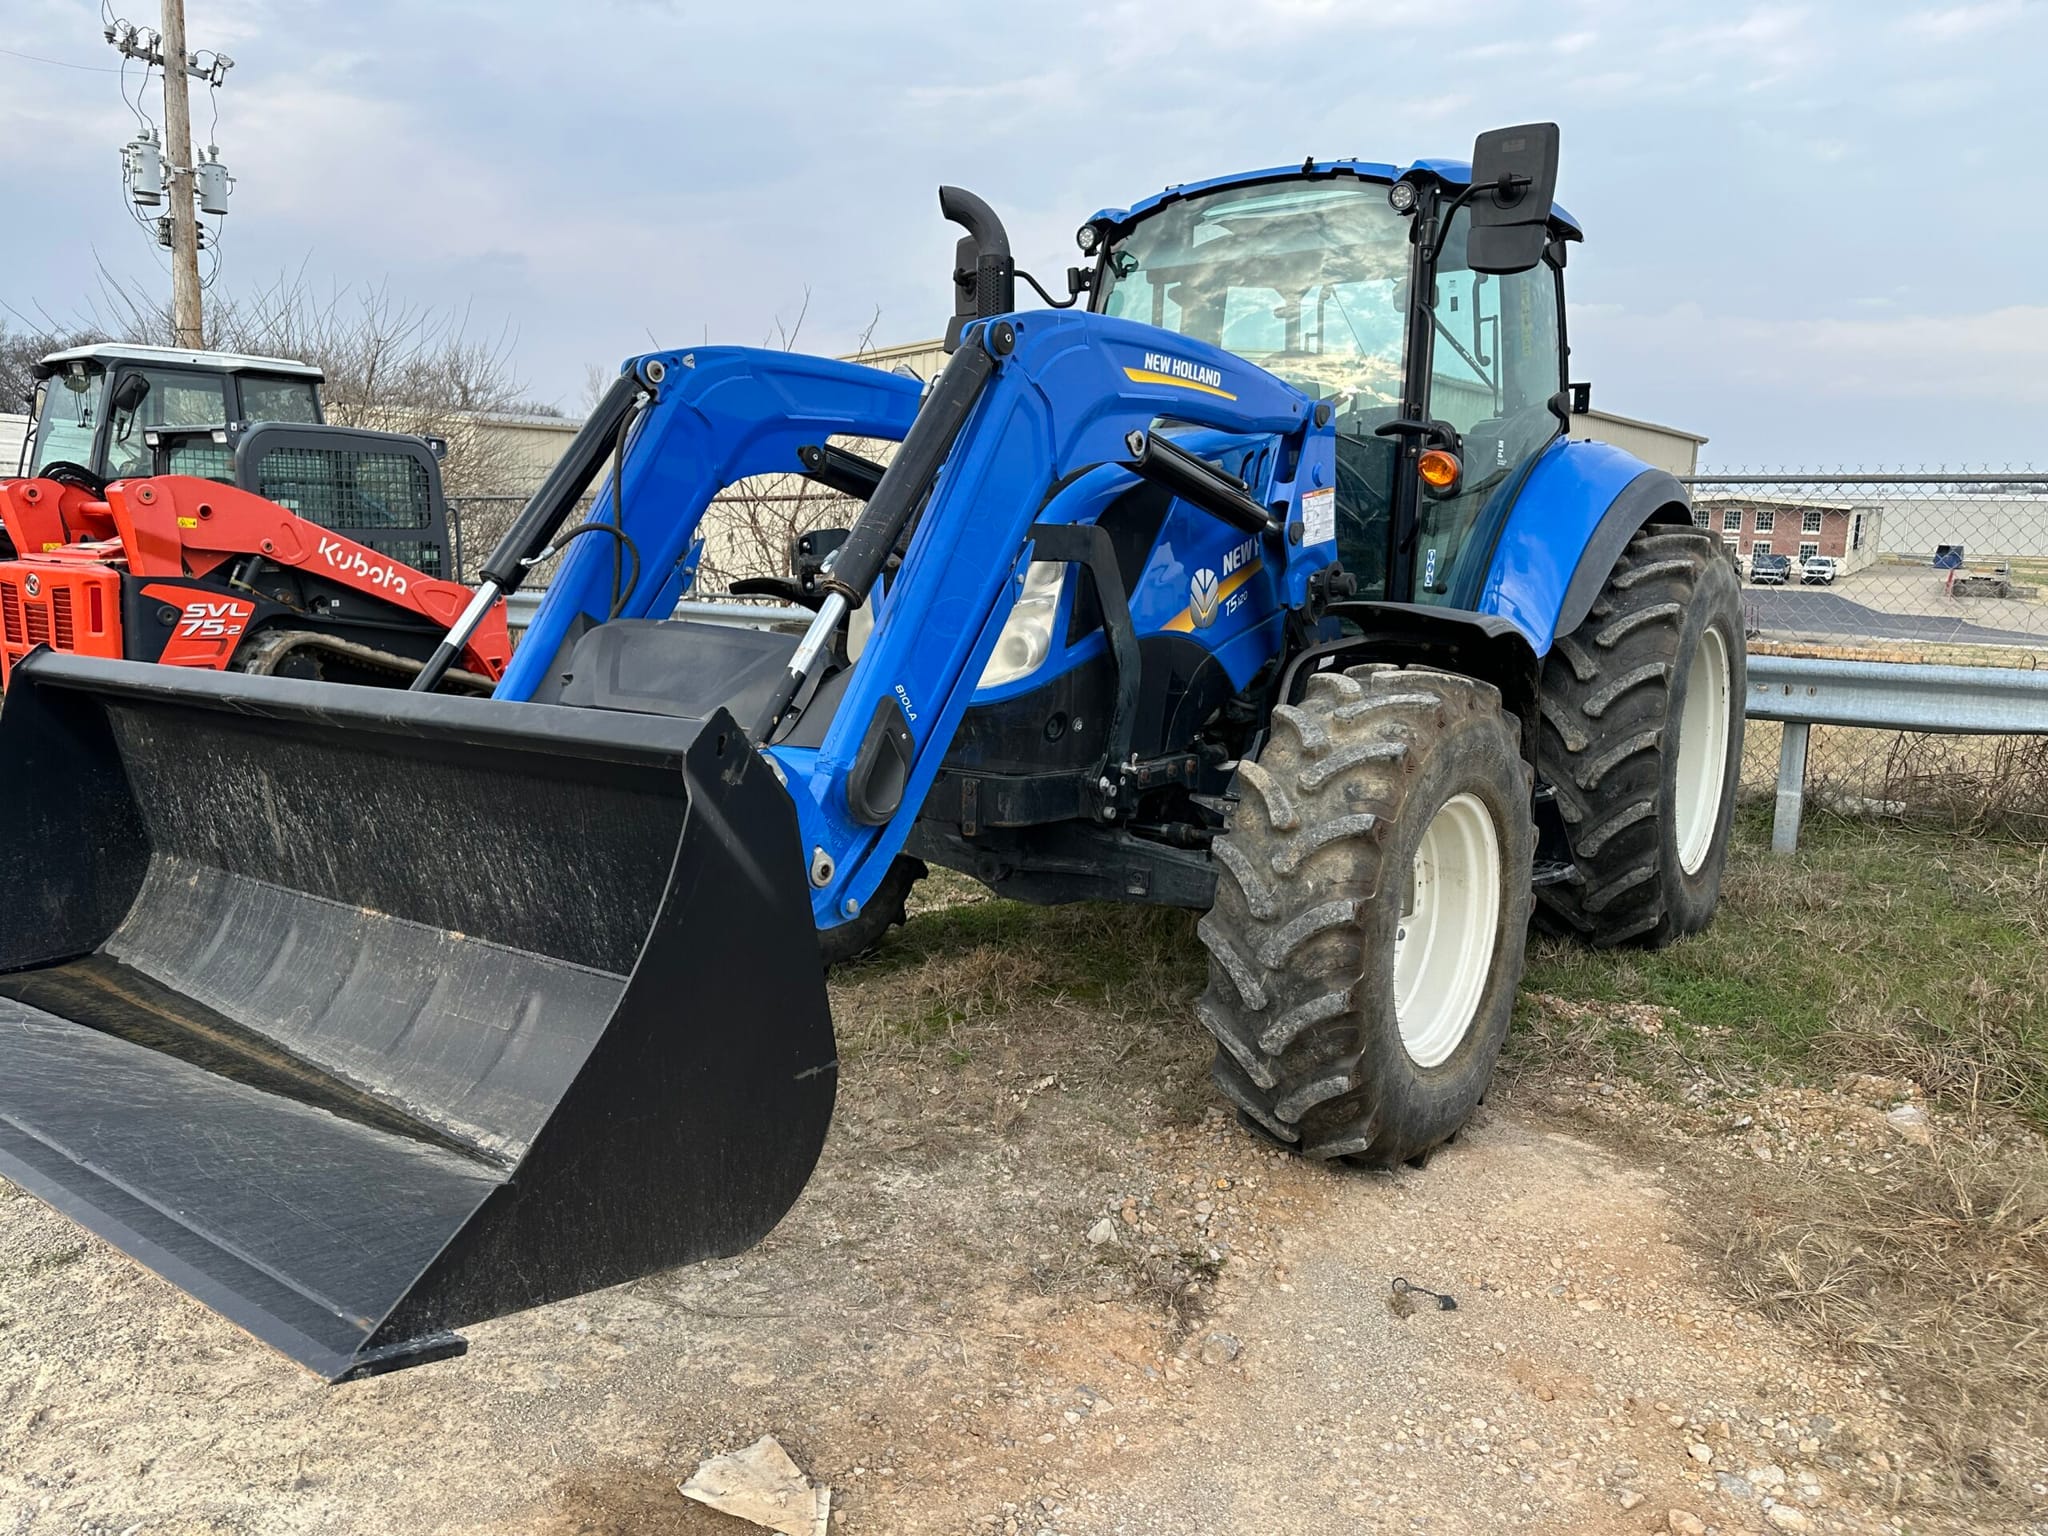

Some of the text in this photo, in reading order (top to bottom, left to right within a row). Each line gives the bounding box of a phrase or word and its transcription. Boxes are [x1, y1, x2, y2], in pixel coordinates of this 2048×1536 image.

[1144, 352, 1221, 388] NEW HOLLAND
[318, 537, 407, 595] Kubota
[1223, 538, 1252, 577] NEW
[183, 603, 249, 618] SVL
